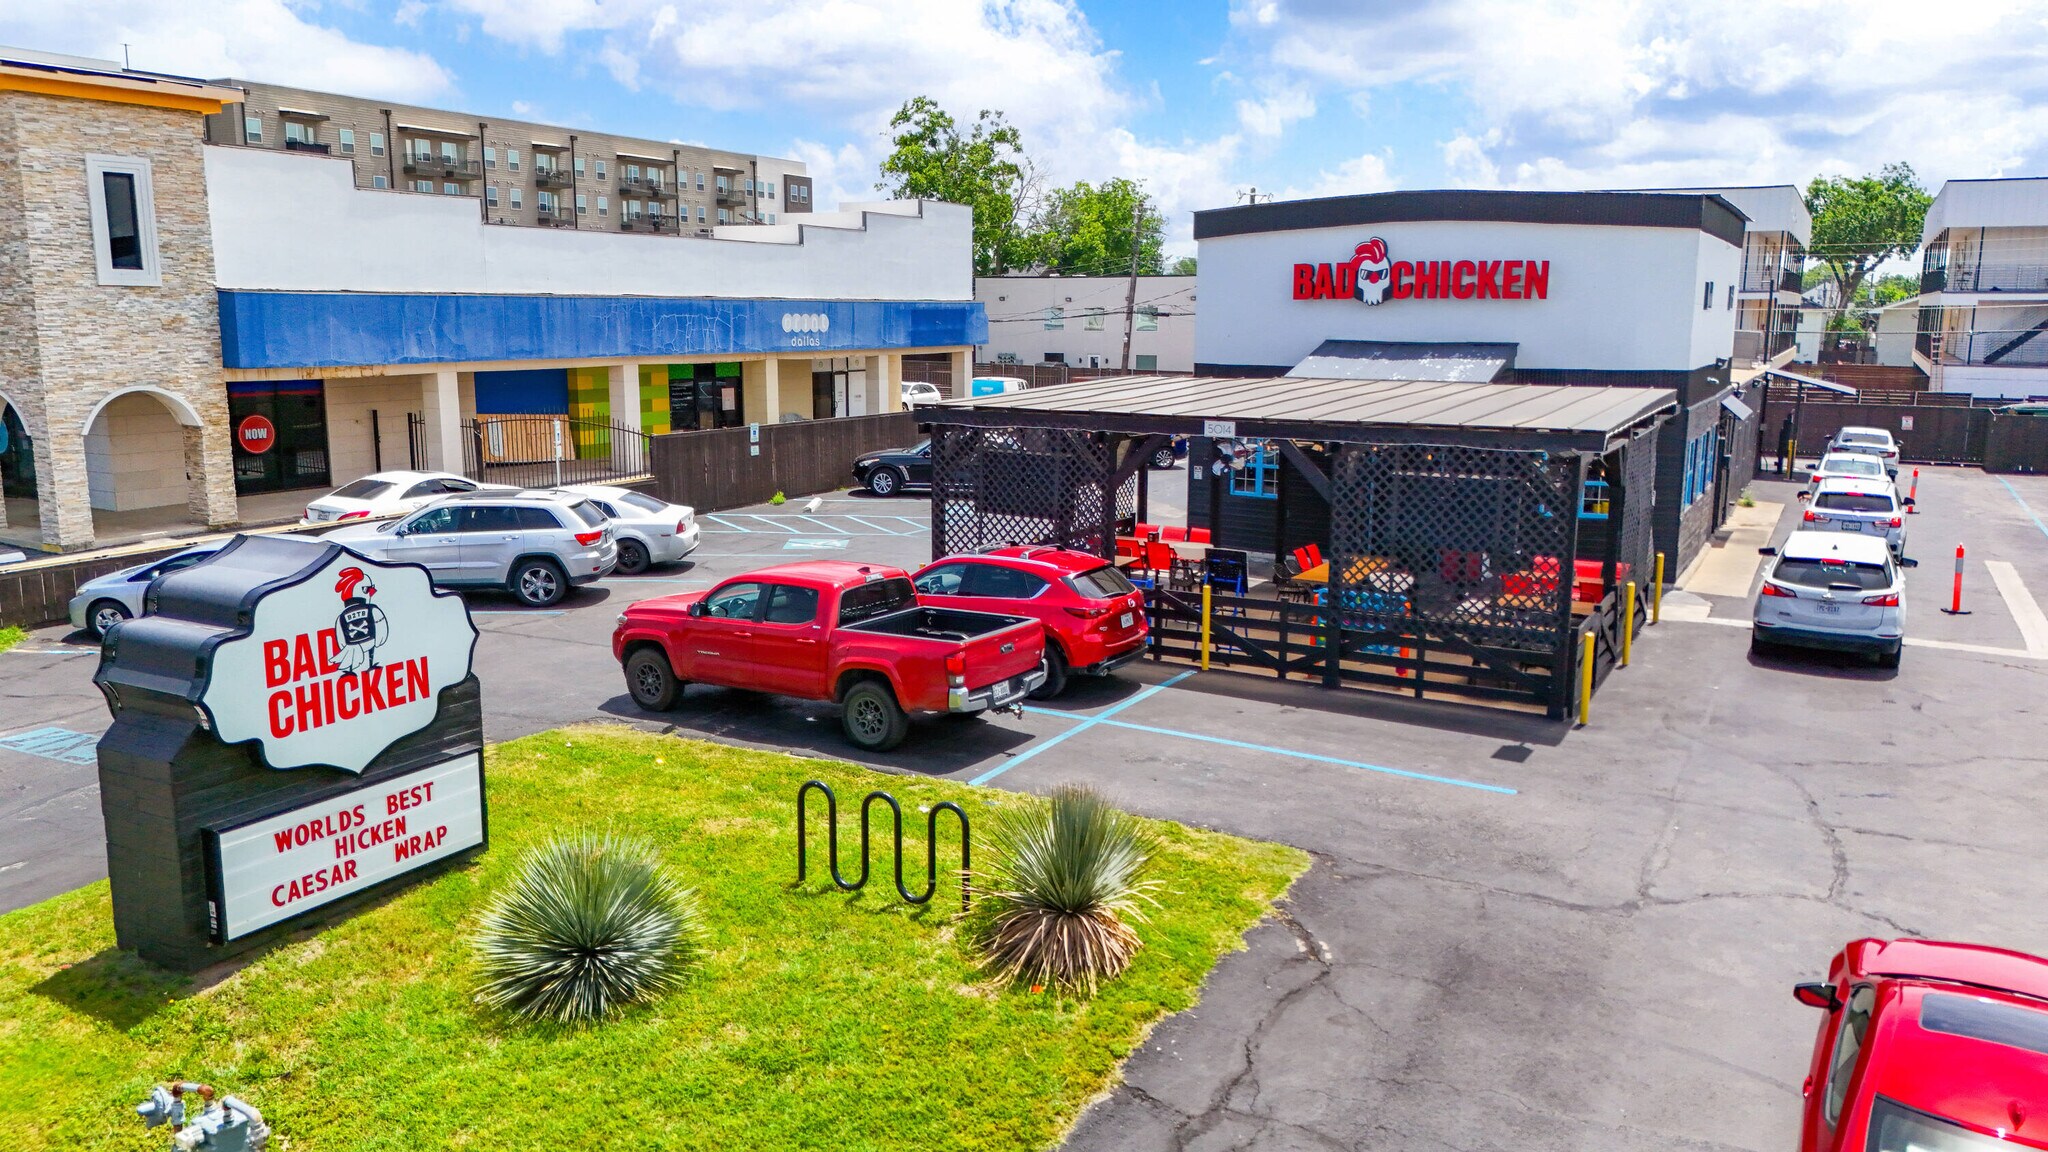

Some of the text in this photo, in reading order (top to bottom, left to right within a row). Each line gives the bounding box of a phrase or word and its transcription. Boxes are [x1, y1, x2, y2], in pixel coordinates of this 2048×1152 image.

[1293, 261, 1549, 300] BAD CHICKEN
[791, 336, 820, 347] dallas
[245, 428, 267, 440] NOW
[1207, 424, 1232, 435] 5014
[264, 627, 341, 688] BAD
[268, 655, 430, 738] CHICKEN
[273, 782, 433, 853] WORLDS BEST
[334, 815, 407, 859] HICKEN
[271, 826, 448, 907] CAESAR WRAP
